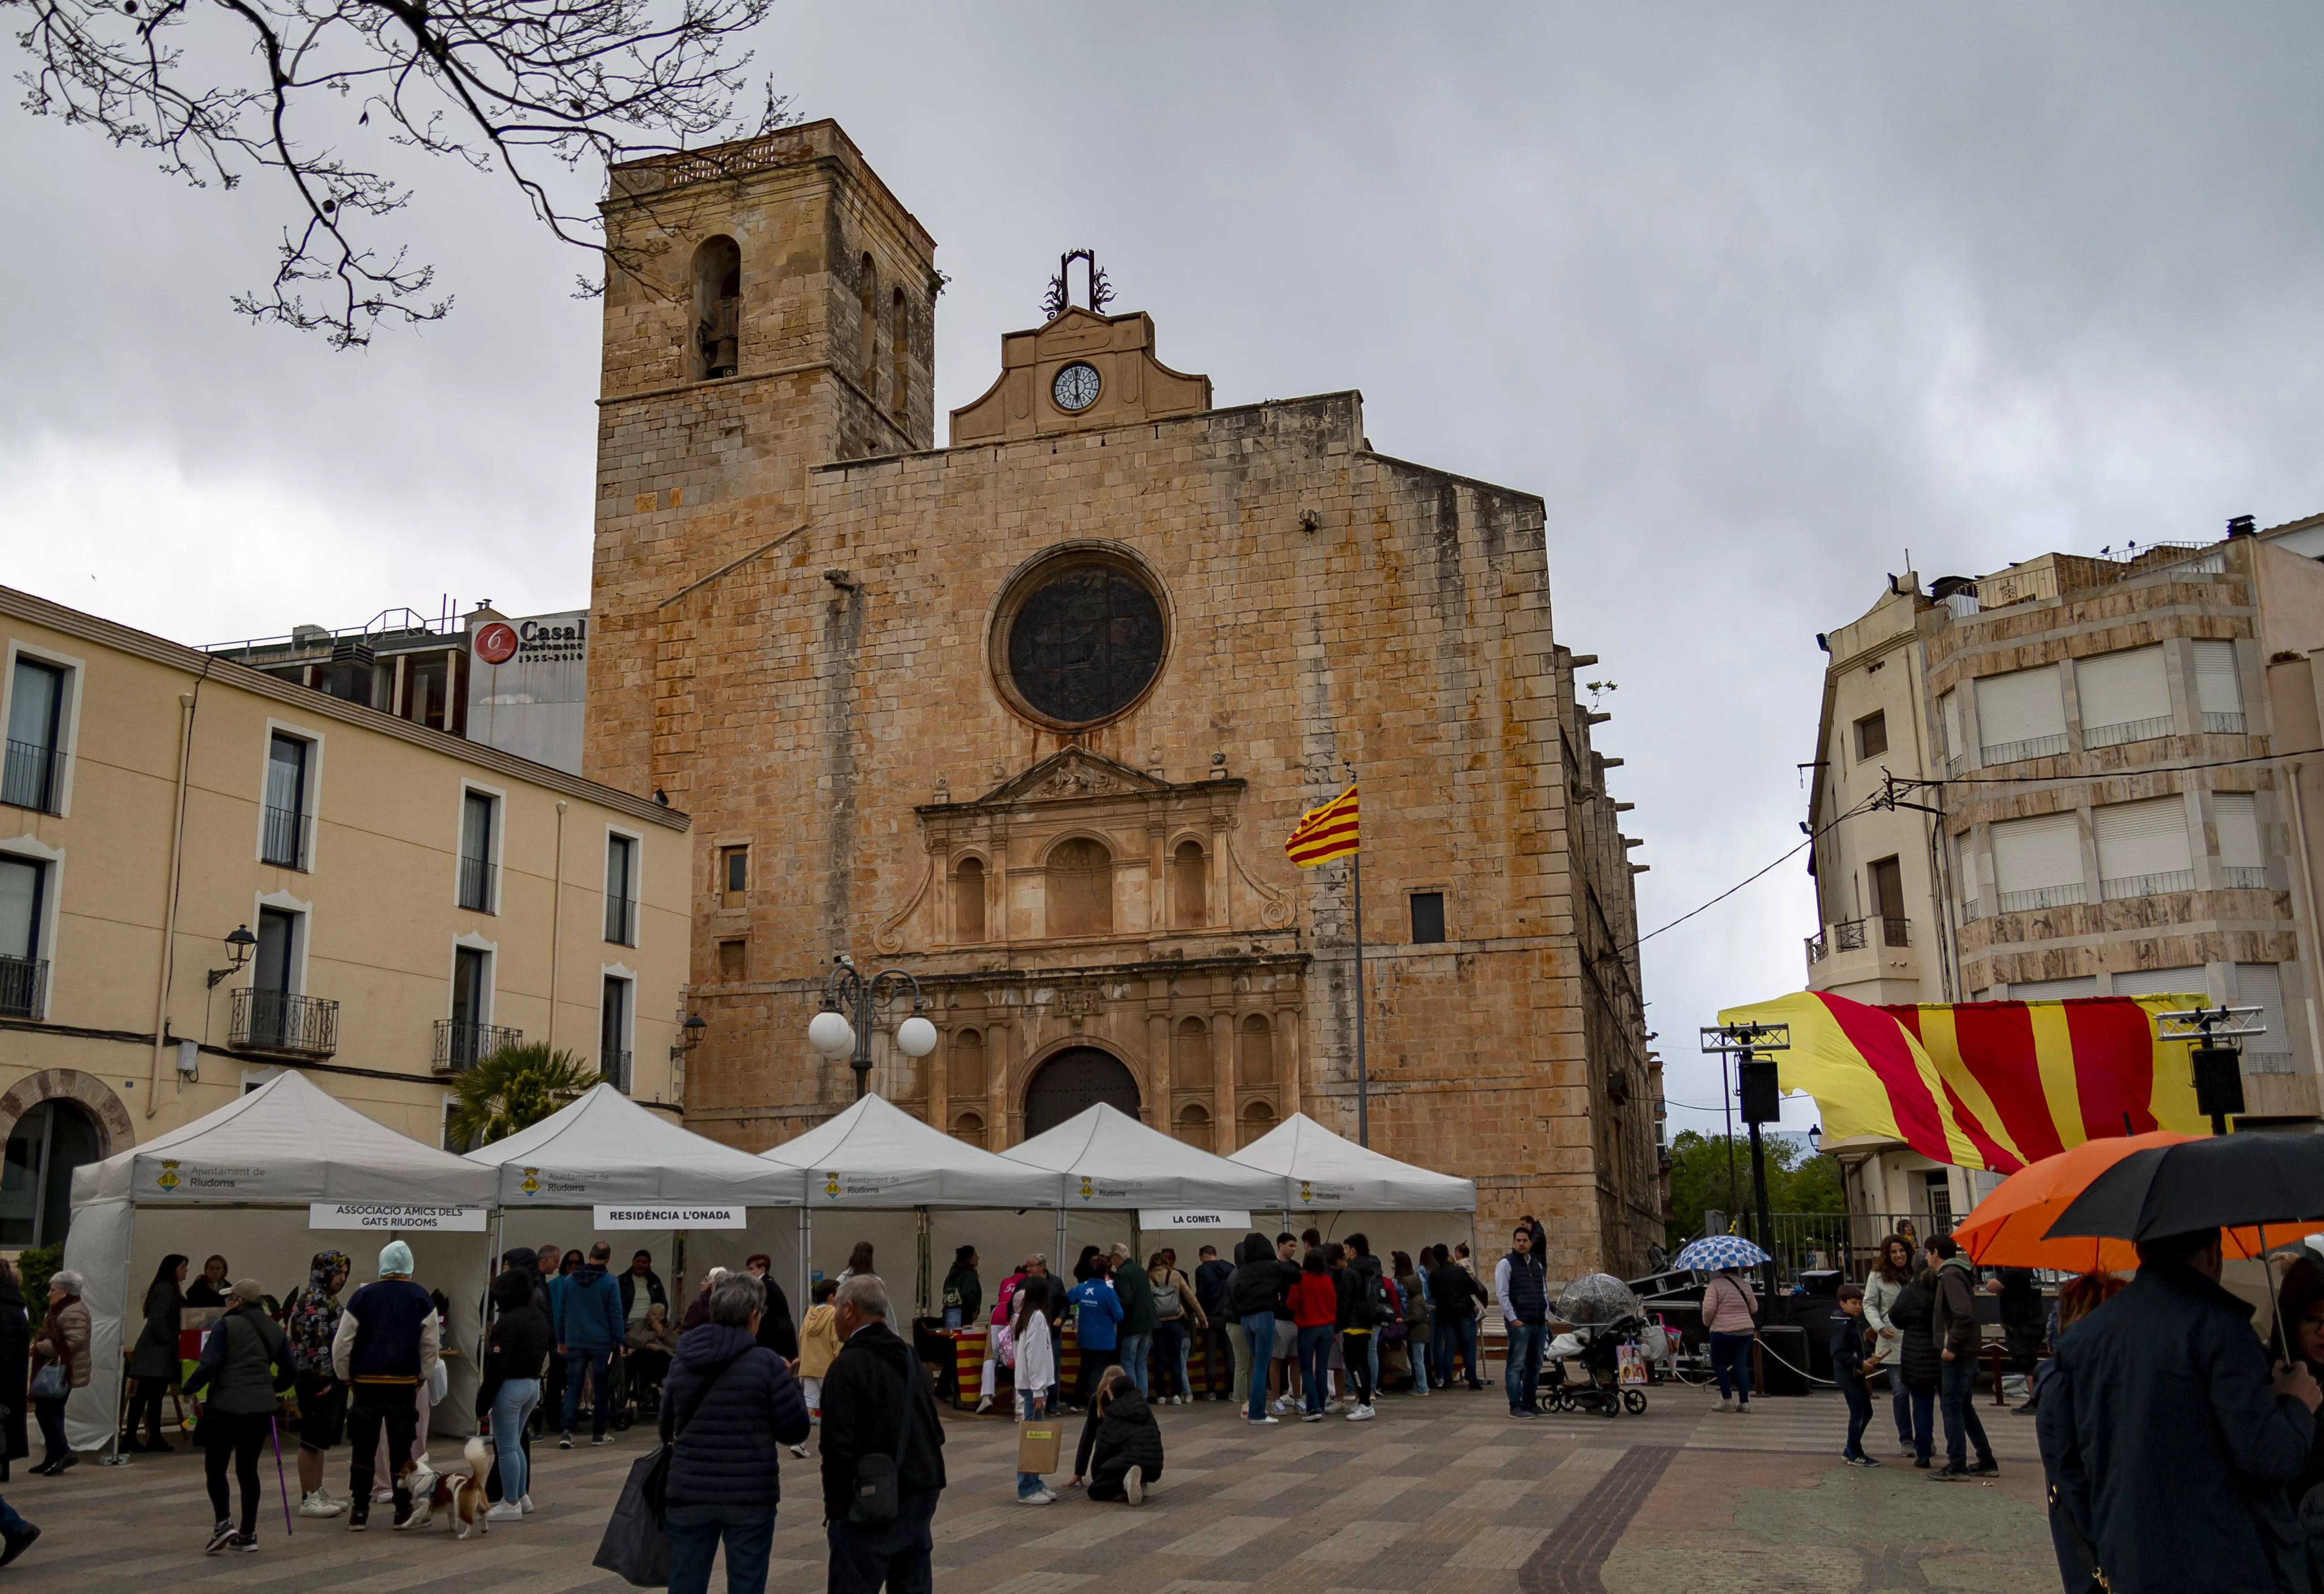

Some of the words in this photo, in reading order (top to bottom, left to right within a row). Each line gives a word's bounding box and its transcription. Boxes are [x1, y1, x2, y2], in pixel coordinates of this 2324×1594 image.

[520, 619, 585, 641] Casal
[518, 653, 583, 663] 1955-2010
[191, 1166, 249, 1176] Ajuntament
[548, 1173, 596, 1181] Ajuntament
[190, 1178, 235, 1187] Riudoms
[548, 1183, 585, 1191] Riudoms
[404, 1207, 436, 1216] AMICS
[439, 1208, 463, 1216] DELS
[610, 1209, 680, 1220] RESIDÈNCIA
[683, 1211, 730, 1219] L'ONADA
[362, 1218, 388, 1226] GATS
[391, 1218, 437, 1227] RIUDOMS
